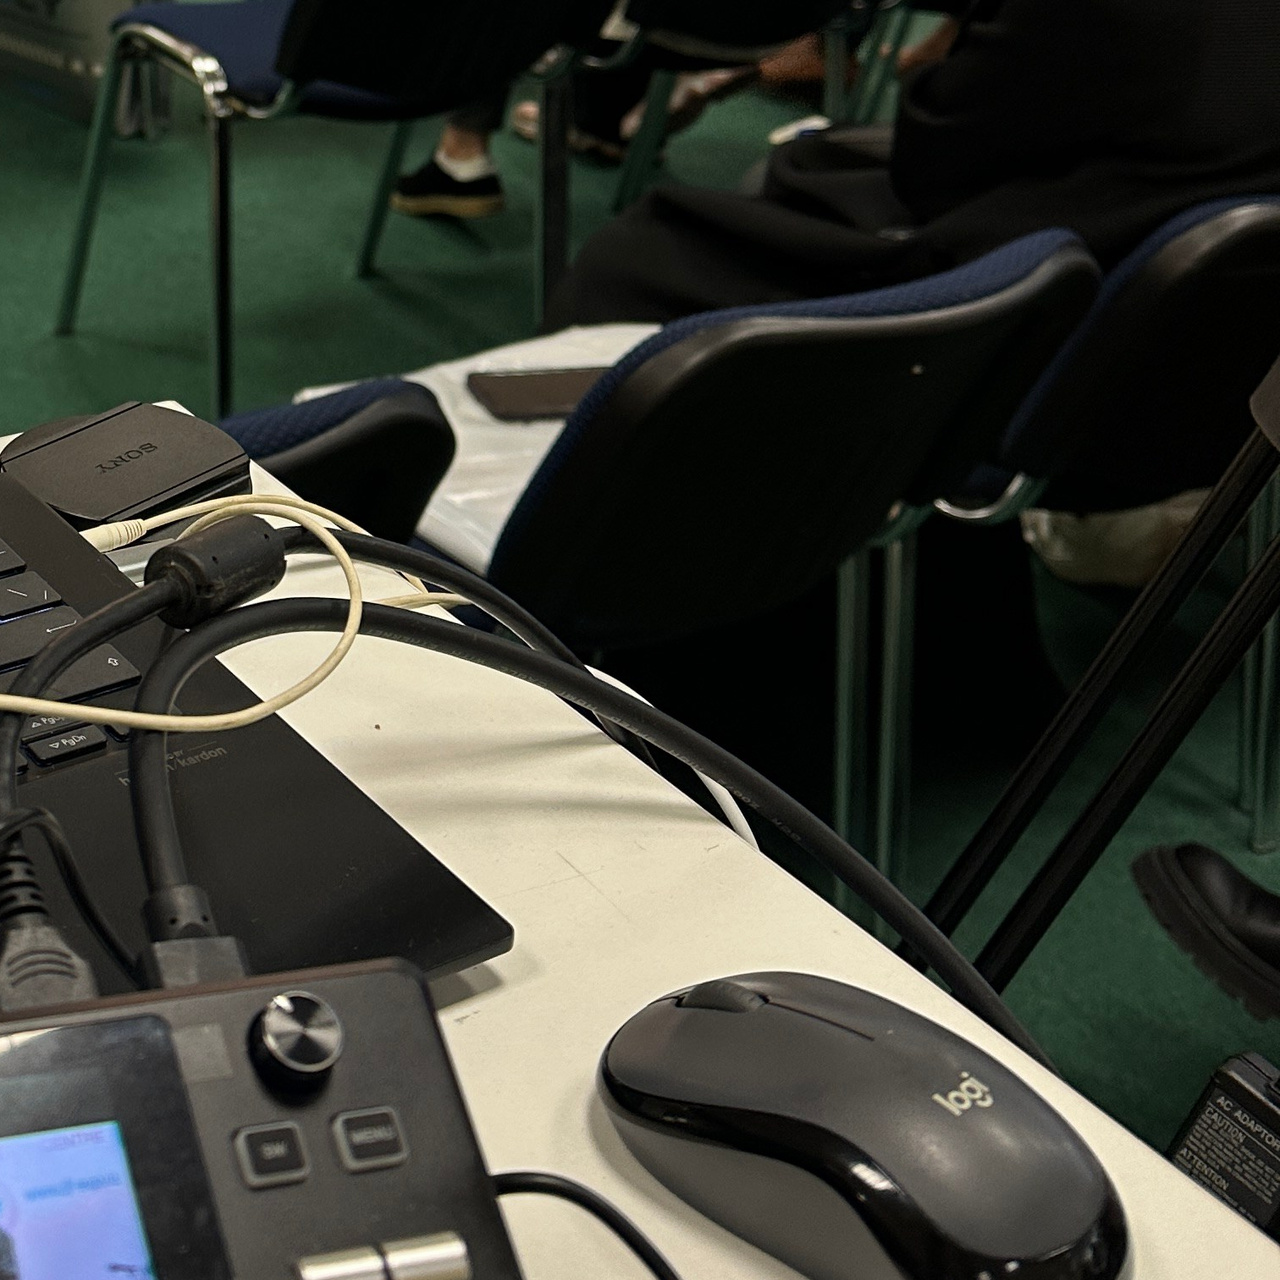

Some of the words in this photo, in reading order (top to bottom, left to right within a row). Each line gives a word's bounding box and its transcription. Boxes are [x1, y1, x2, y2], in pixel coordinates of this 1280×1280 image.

[95, 442, 158, 474] SONY
[60, 732, 87, 748] PgDn
[931, 1071, 995, 1118] logi
[1216, 1095, 1234, 1112] AC
[1204, 1107, 1247, 1144] CAUTION
[1179, 1148, 1230, 1192] ATTENTION
